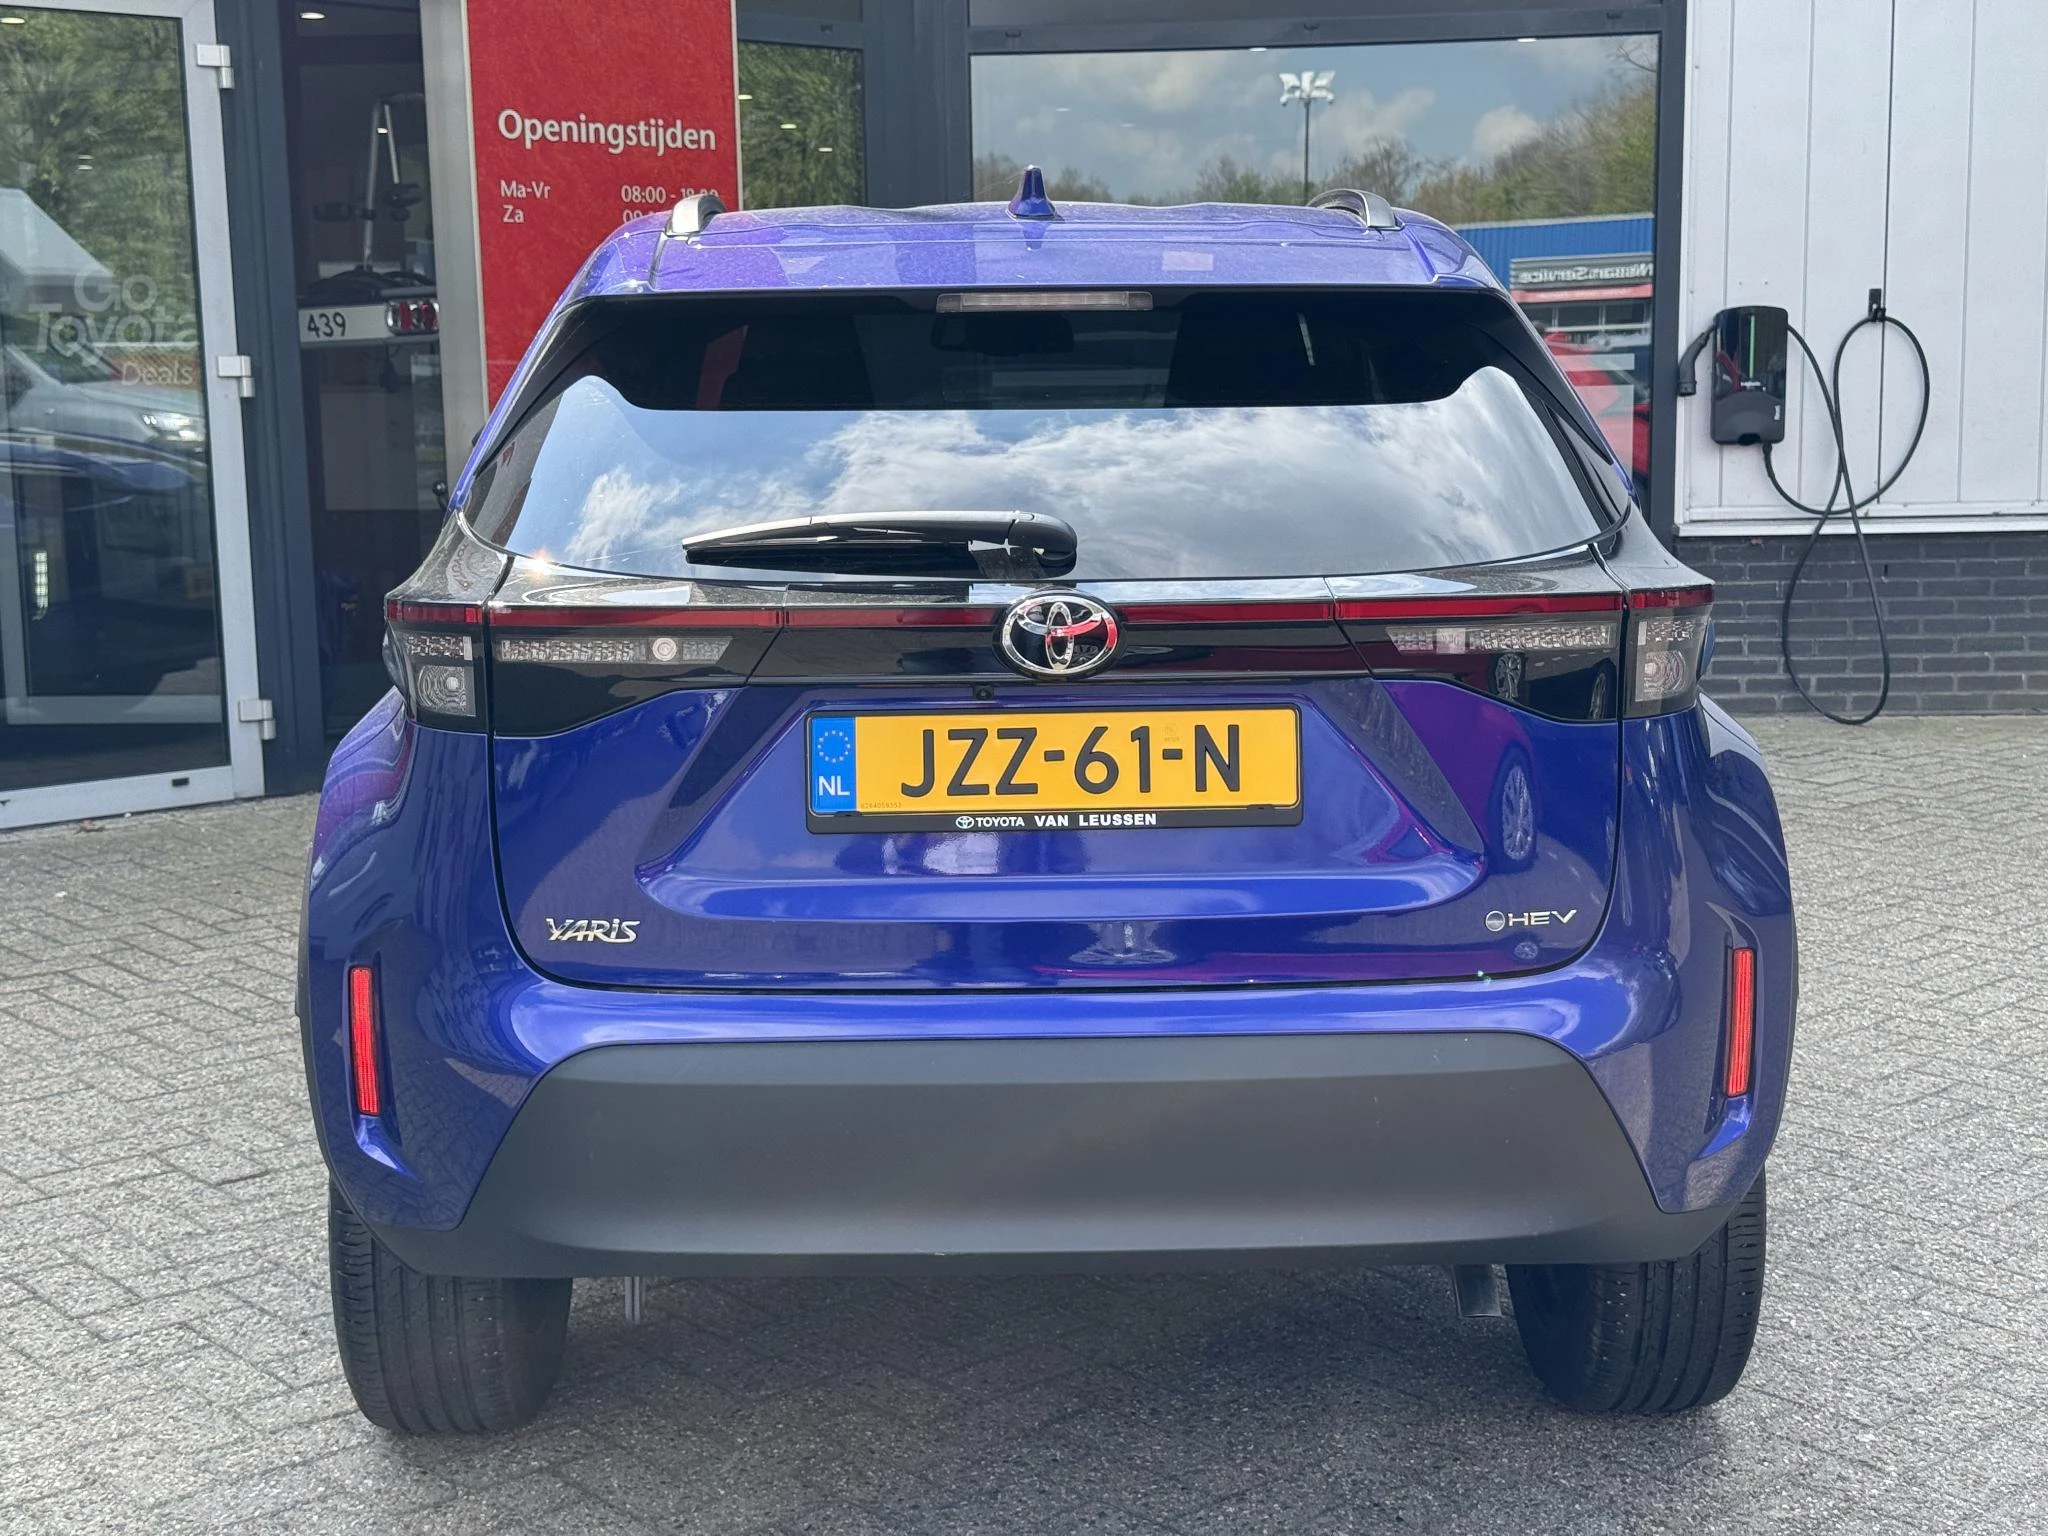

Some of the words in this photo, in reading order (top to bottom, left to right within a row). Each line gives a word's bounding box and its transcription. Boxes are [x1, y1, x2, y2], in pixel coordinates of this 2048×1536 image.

[498, 109, 716, 156] Openingstijden
[500, 180, 550, 200] Ma-Vr
[621, 185, 666, 204] 08:00
[502, 204, 524, 223] Za
[74, 267, 157, 312] Go
[307, 312, 346, 338] 439
[121, 360, 194, 386] Deals
[901, 724, 1240, 797] JZZ-61-N
[818, 775, 850, 796] NL
[976, 816, 1025, 828] TOYOTA
[1034, 815, 1069, 827] VAN
[1079, 813, 1157, 826] LEUSSEN
[1508, 909, 1577, 926] HEV
